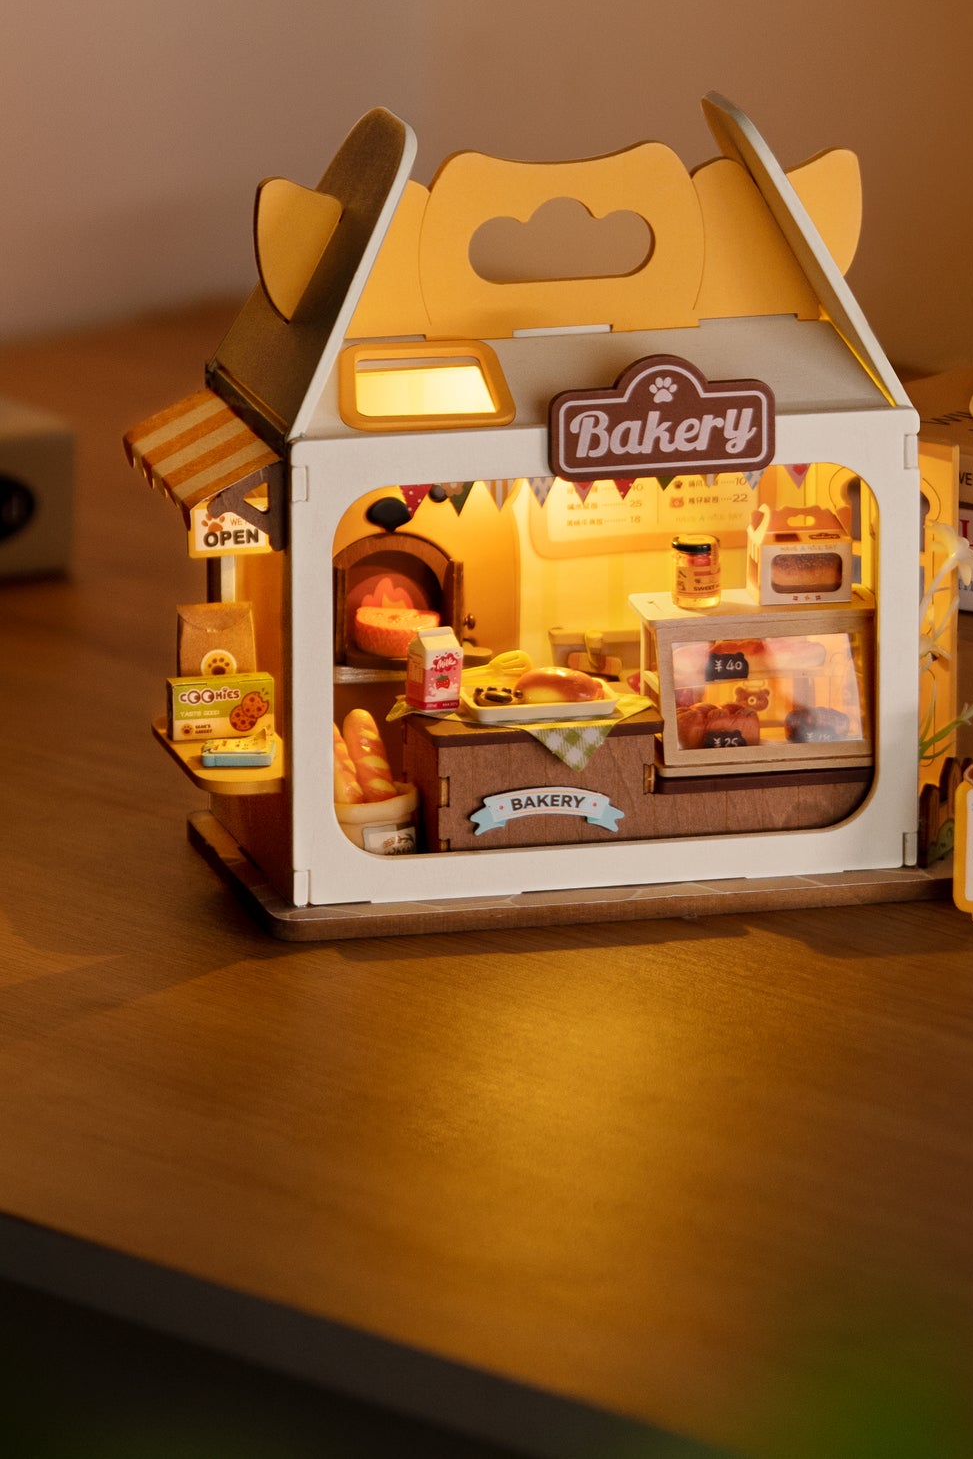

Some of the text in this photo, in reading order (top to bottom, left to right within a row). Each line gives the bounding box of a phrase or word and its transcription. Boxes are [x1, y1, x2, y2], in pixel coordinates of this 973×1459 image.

[570, 408, 757, 458] Bakery
[204, 528, 259, 548] OPEN
[510, 794, 586, 811] BAKERY
